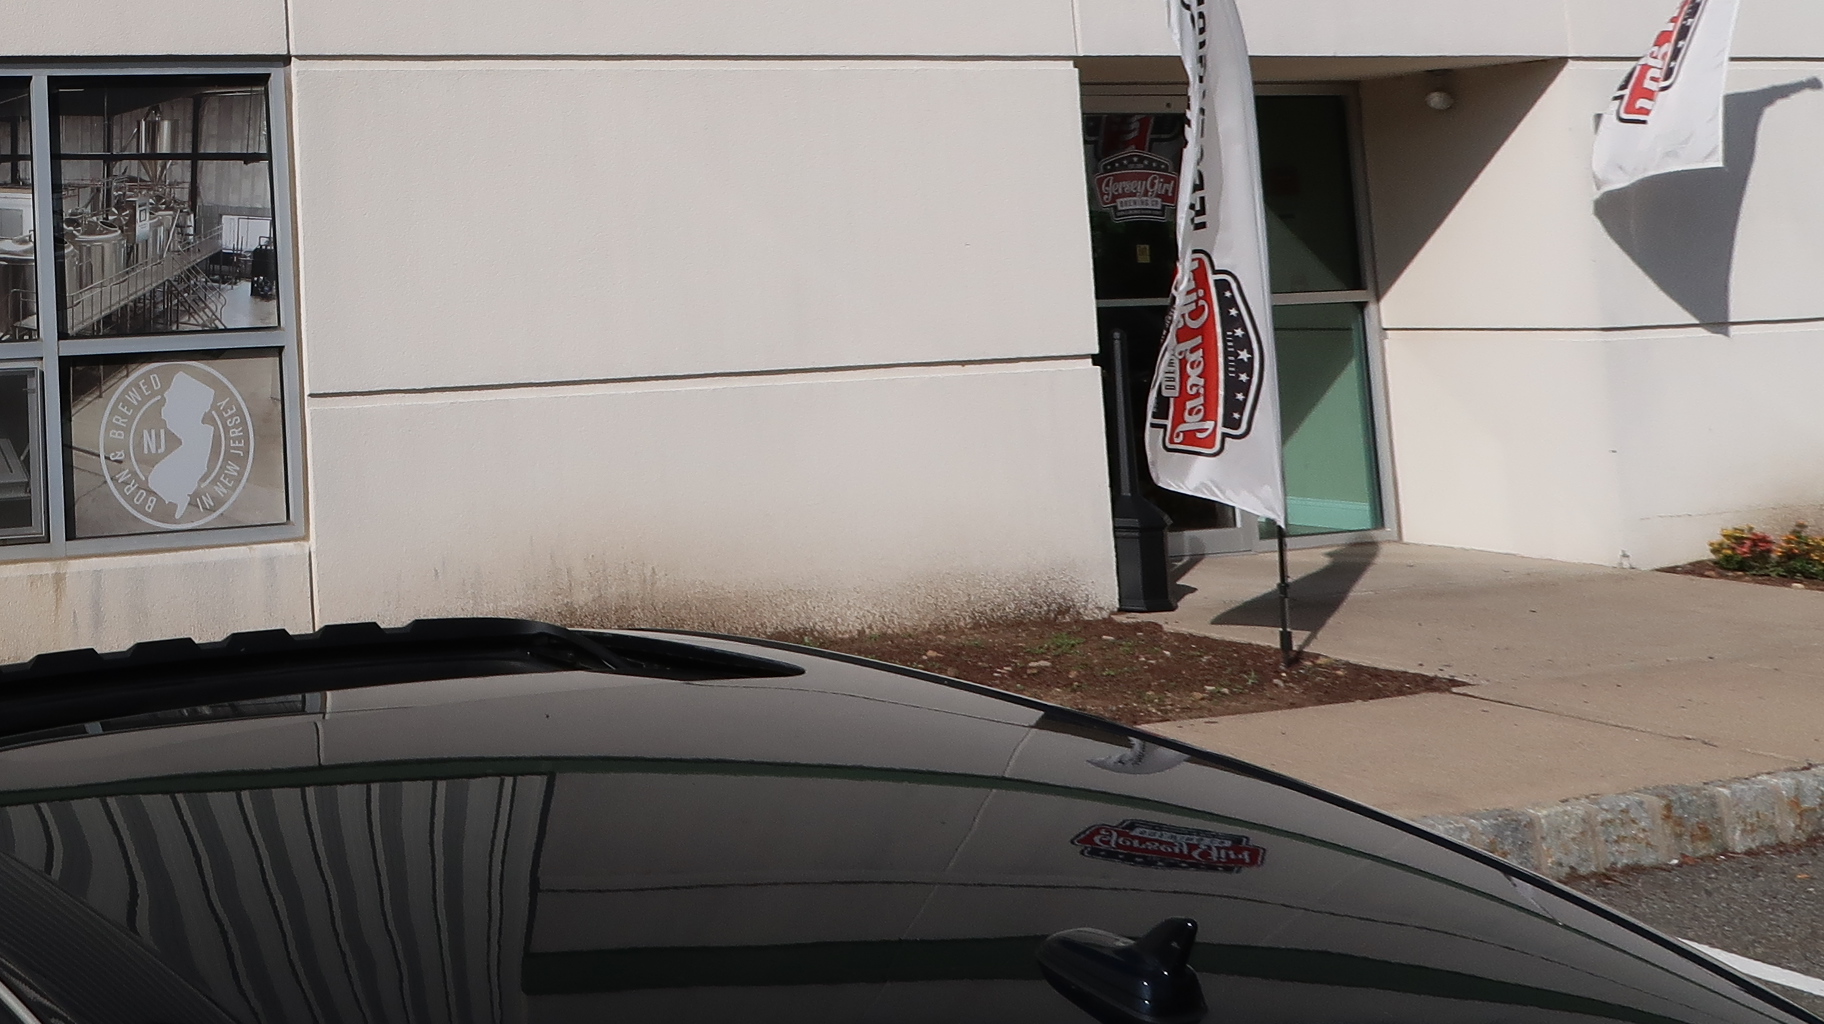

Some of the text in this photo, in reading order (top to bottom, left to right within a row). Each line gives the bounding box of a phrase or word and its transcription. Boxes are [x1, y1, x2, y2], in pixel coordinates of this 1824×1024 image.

[1101, 174, 1175, 203] Jersey Girl
[109, 373, 162, 513] BORN & BREWED
[142, 428, 166, 455] NJ
[196, 397, 245, 513] IN NEW JERSEY
